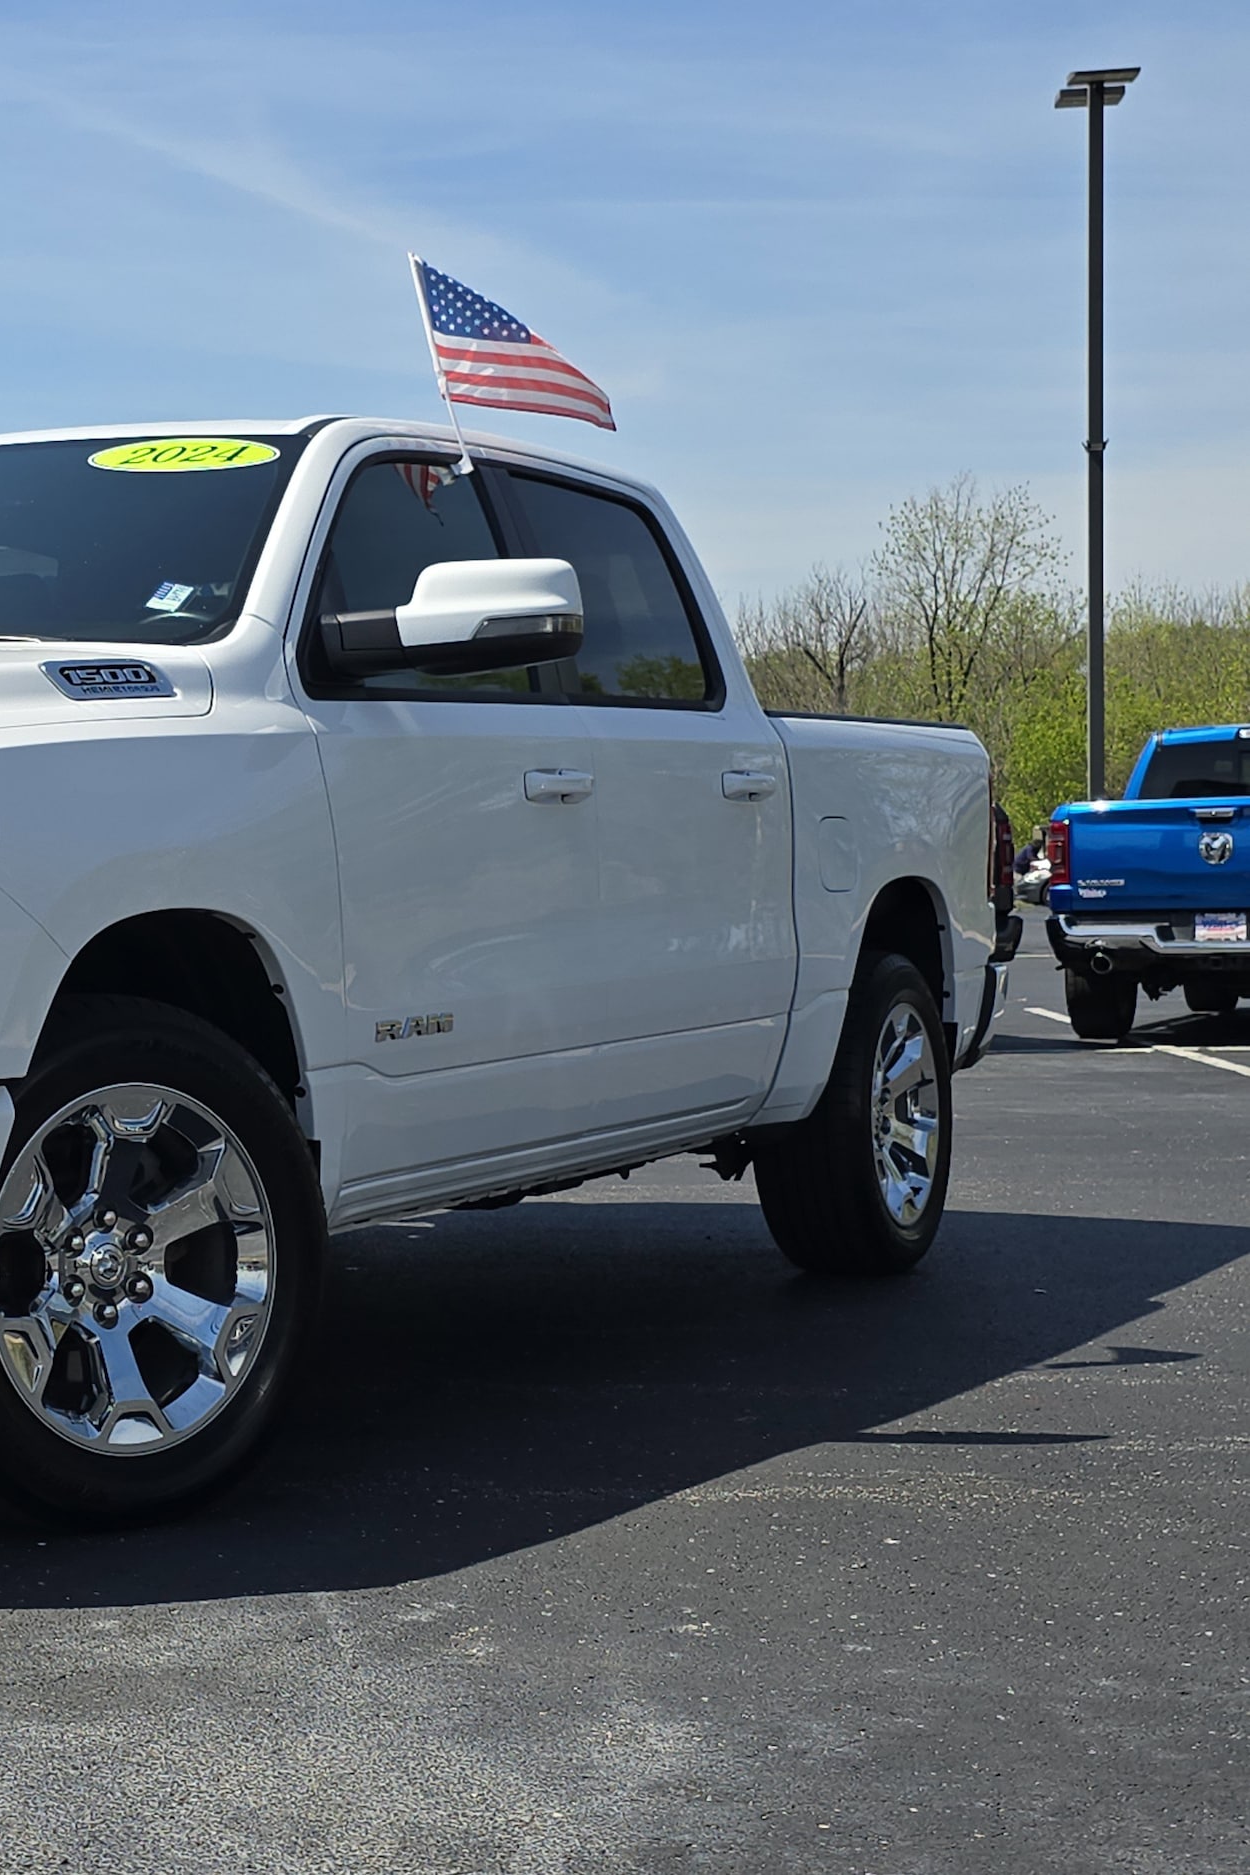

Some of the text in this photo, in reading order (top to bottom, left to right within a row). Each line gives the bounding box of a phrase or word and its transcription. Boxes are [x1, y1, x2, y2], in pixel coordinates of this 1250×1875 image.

[119, 445, 250, 465] 2024
[62, 667, 150, 684] 1500
[81, 685, 113, 694] HEMI
[374, 1012, 454, 1043] RAM
